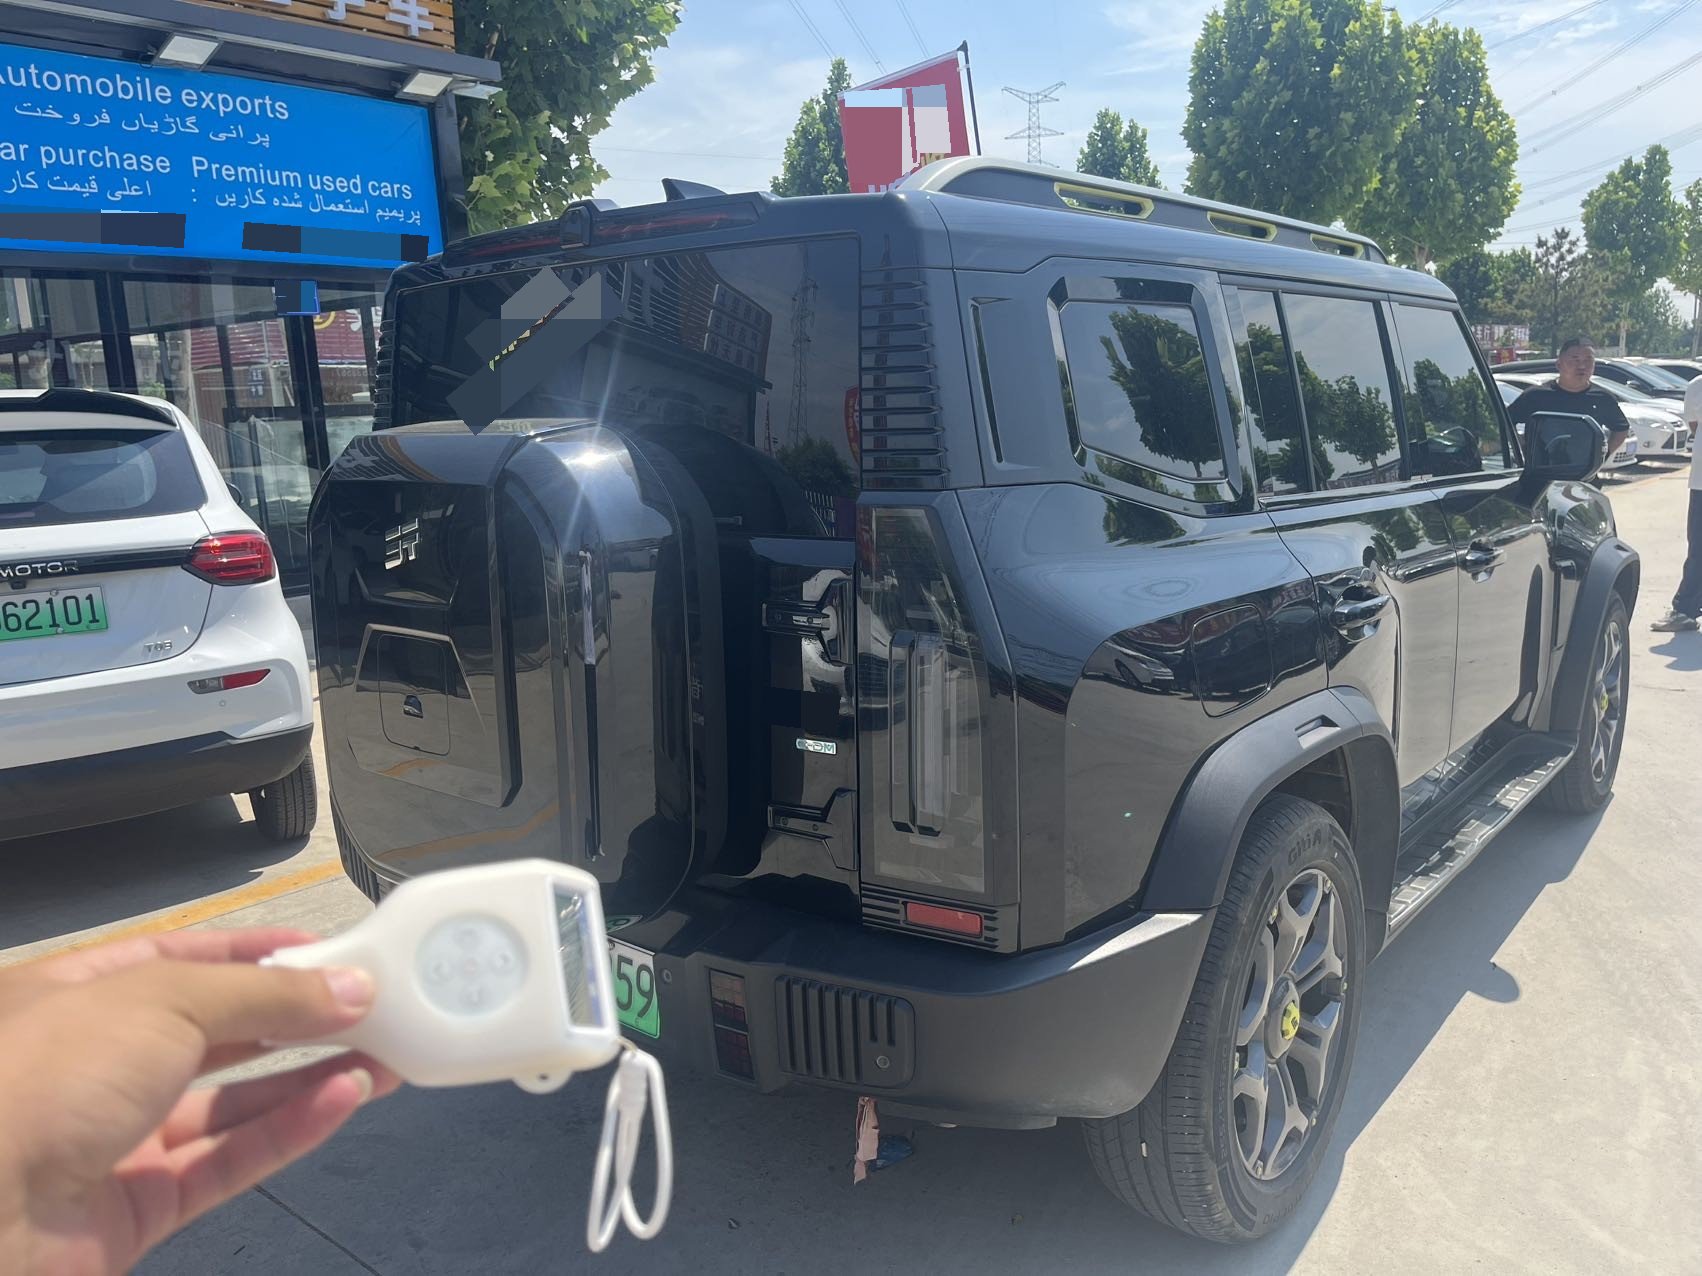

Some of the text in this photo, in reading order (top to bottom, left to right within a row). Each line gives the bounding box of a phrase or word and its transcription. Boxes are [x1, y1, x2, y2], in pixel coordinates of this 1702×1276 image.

[181, 88, 289, 120] exports
[40, 145, 171, 174] purchase
[191, 155, 413, 200] Premium used cars
[0, 560, 79, 577] MOTOR
[0, 593, 100, 633] 62101
[611, 954, 655, 1019] 59
